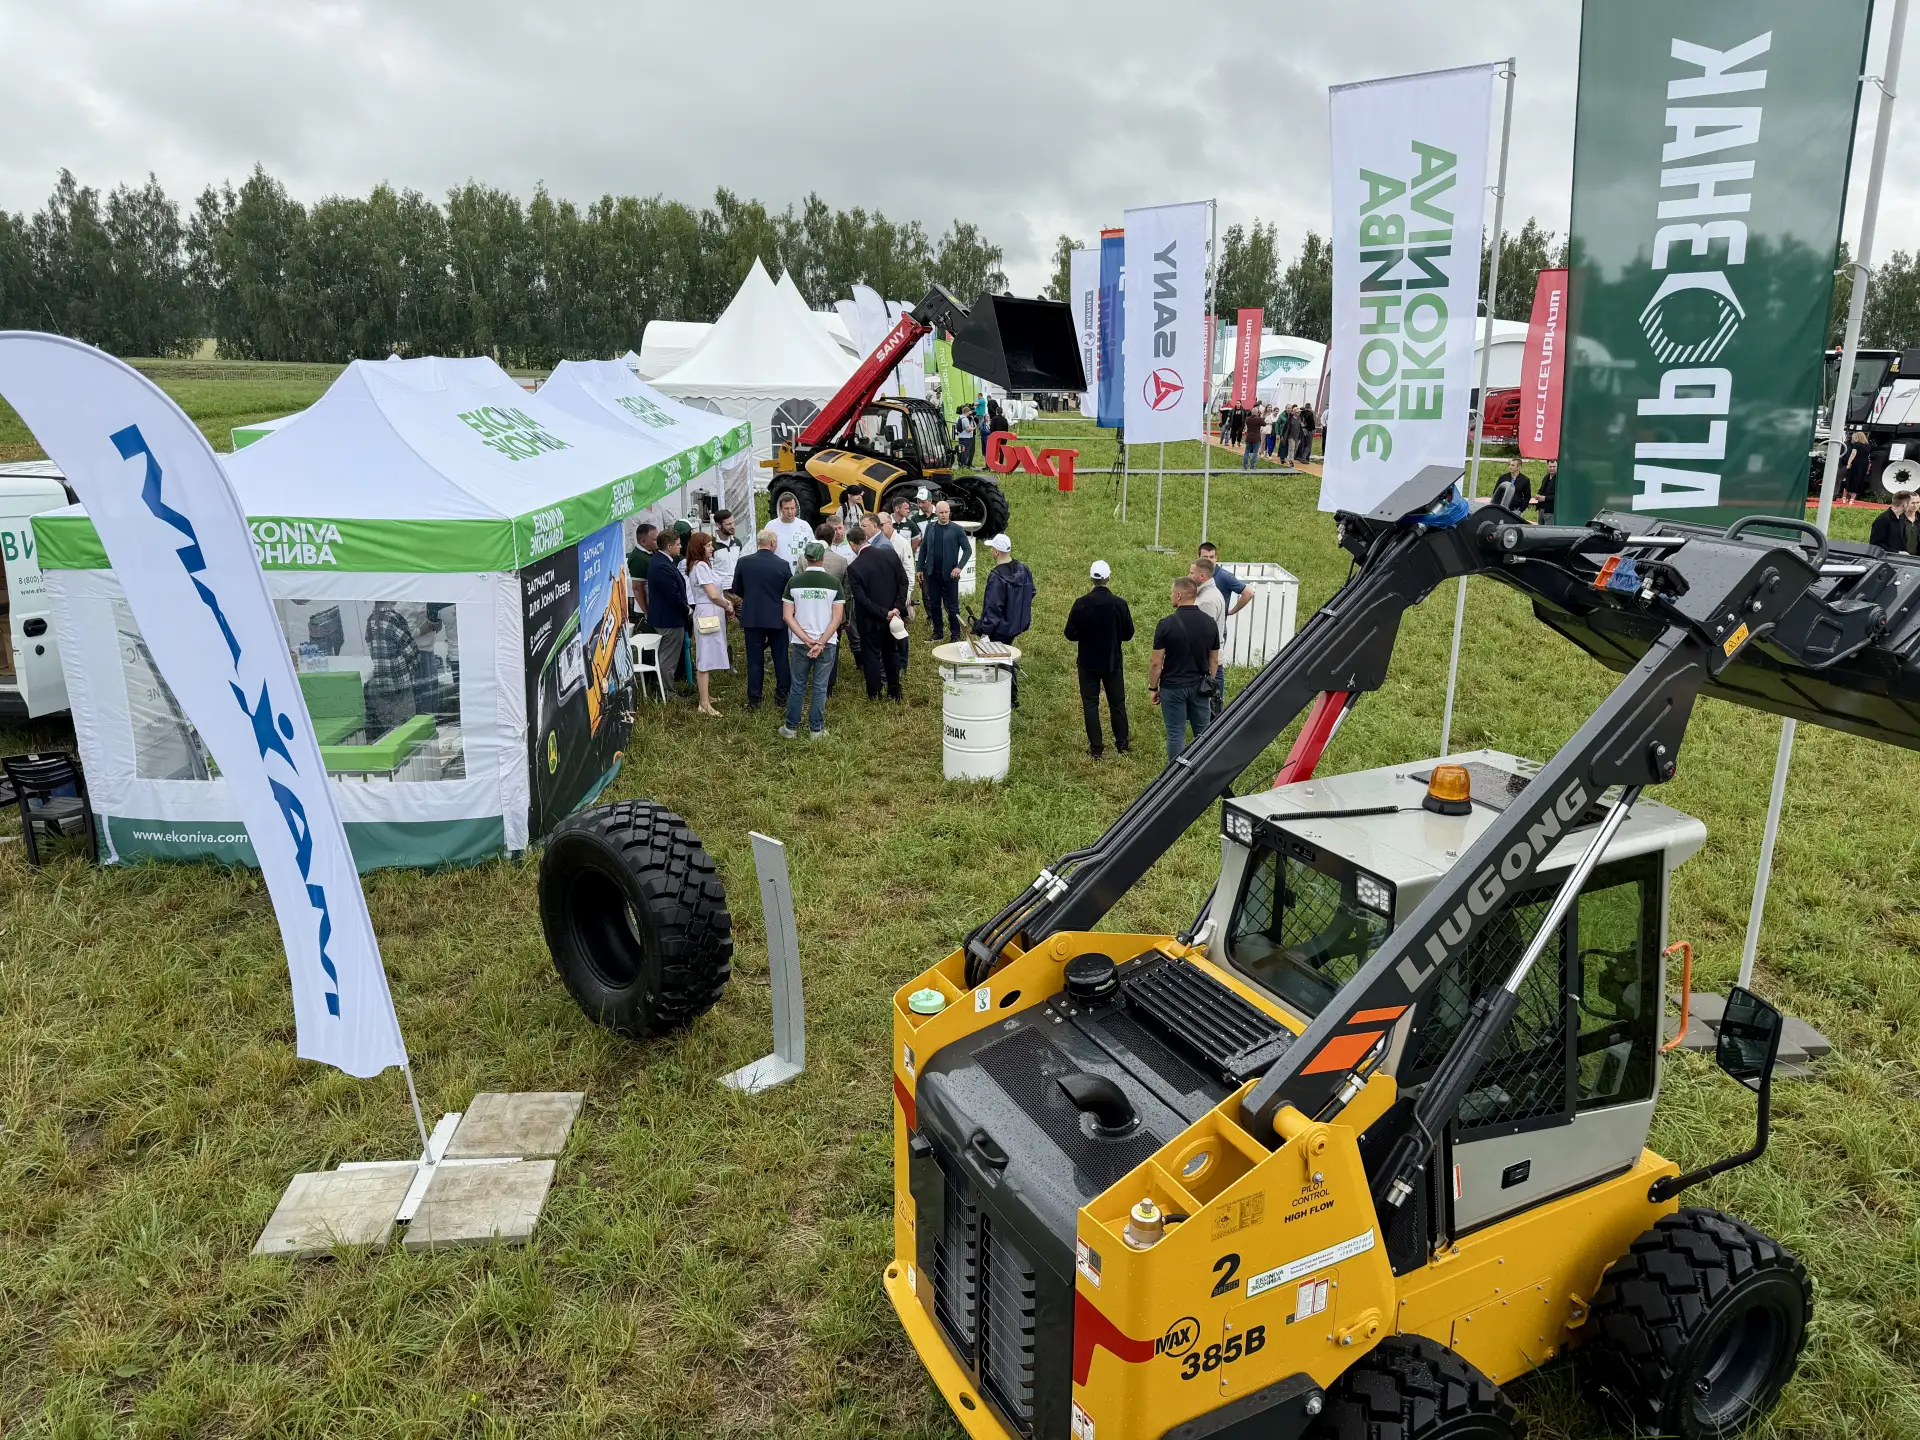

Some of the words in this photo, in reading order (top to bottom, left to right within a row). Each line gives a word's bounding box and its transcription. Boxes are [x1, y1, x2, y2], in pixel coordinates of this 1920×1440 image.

[876, 326, 905, 363] SANY
[457, 407, 545, 438] EKONIVA
[482, 431, 574, 461] ЭКОНИВА
[532, 508, 565, 532] EKONIVA
[248, 521, 343, 544] KONIVA
[530, 527, 564, 556] ЭКОНИВА
[254, 543, 337, 565] ОНИВА
[20, 587, 46, 595] www.eko
[527, 569, 555, 595] ЗАПЧАСТИ
[943, 723, 966, 740] ОЗНАК
[132, 829, 249, 845] www.ekoniva.com
[1395, 777, 1588, 993] LIUGONG
[1292, 1189, 1330, 1207] CONTROL
[1301, 1181, 1325, 1194] PILOT
[1284, 1209, 1308, 1223] HIGH
[1309, 1200, 1335, 1215] FLOW
[1211, 1253, 1241, 1298] 2
[1255, 1269, 1284, 1284] EKONIVA
[1213, 1280, 1239, 1297] SPEED
[1155, 1325, 1191, 1356] MAX
[1180, 1325, 1266, 1381] 385B
